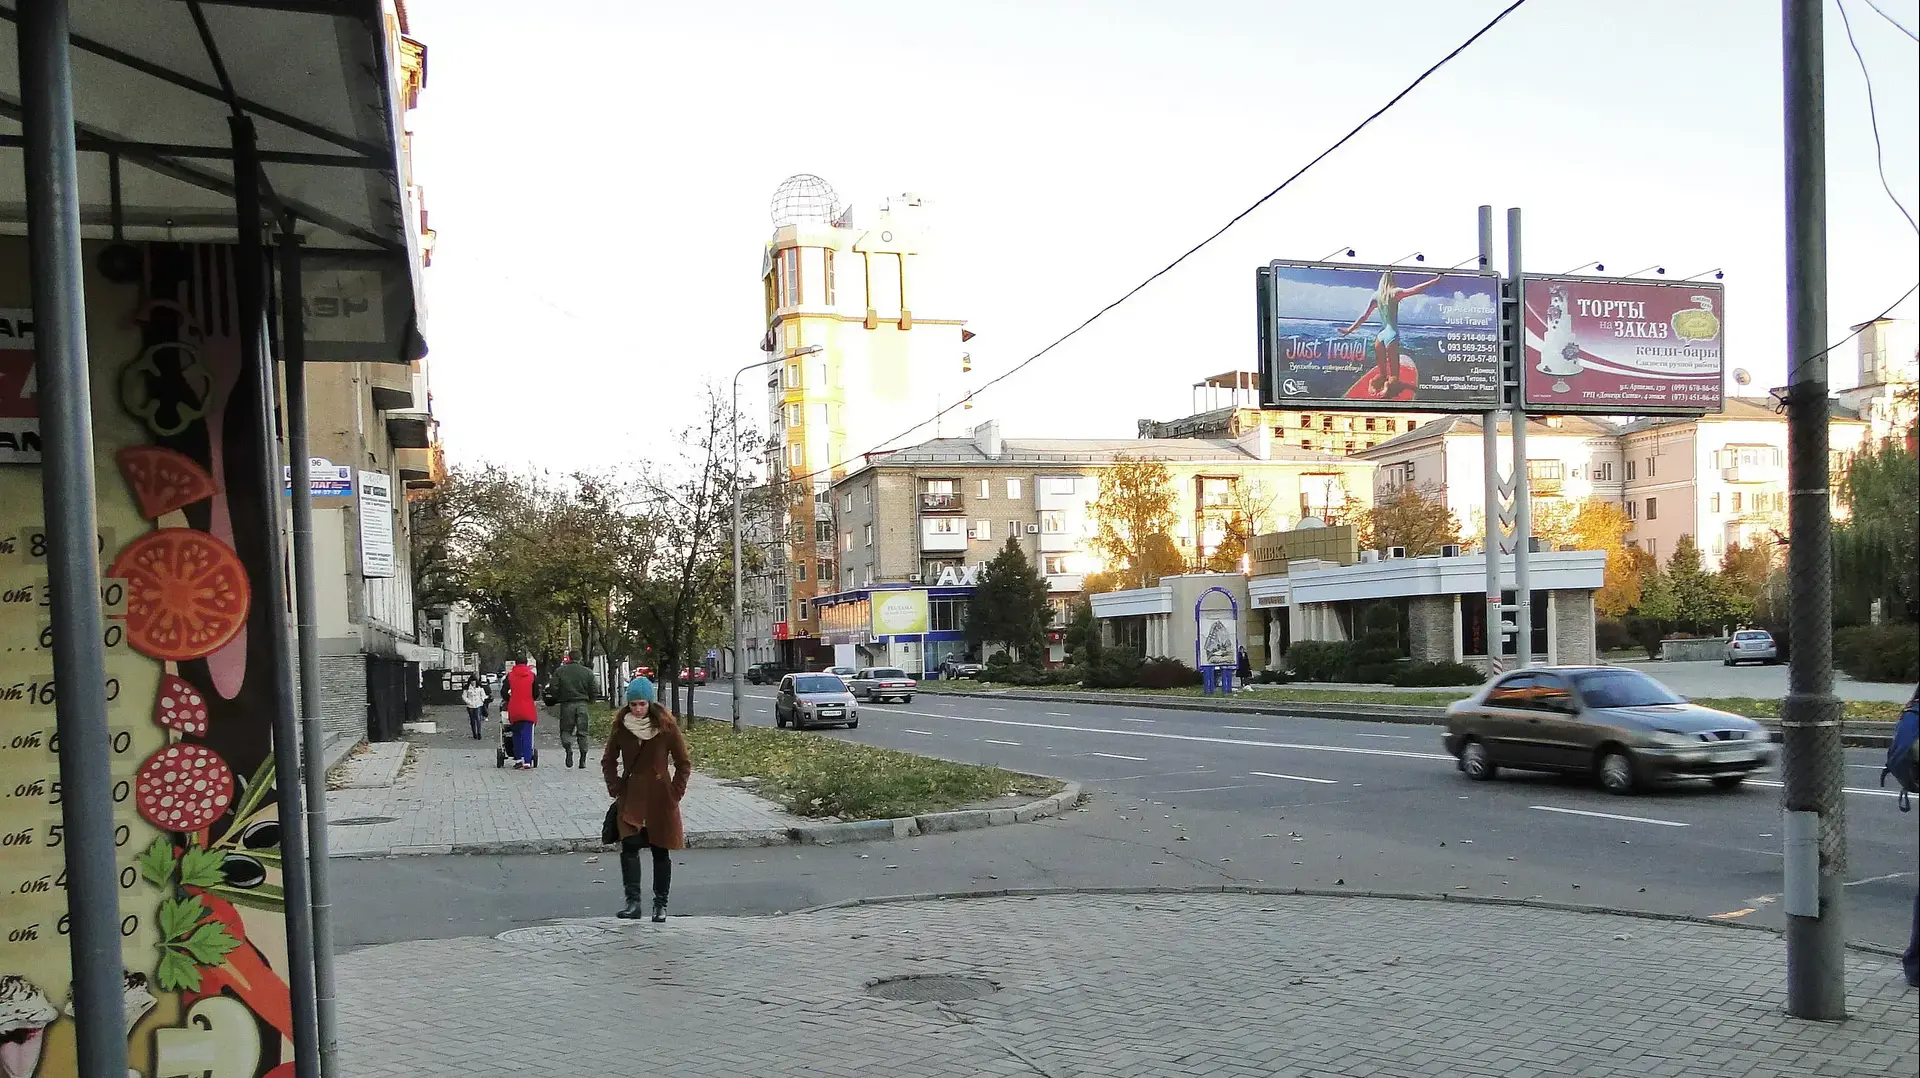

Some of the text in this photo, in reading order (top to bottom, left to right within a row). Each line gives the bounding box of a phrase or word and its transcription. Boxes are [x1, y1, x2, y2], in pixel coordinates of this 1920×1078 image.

[1438, 303, 1453, 314] Тур
[1577, 299, 1646, 320] ТОРТЫ
[1448, 333, 1461, 341] 095
[1599, 321, 1668, 339] на ЗАКАЗ
[1286, 335, 1367, 361] Just Travel
[1635, 344, 1719, 361] кенди-бары
